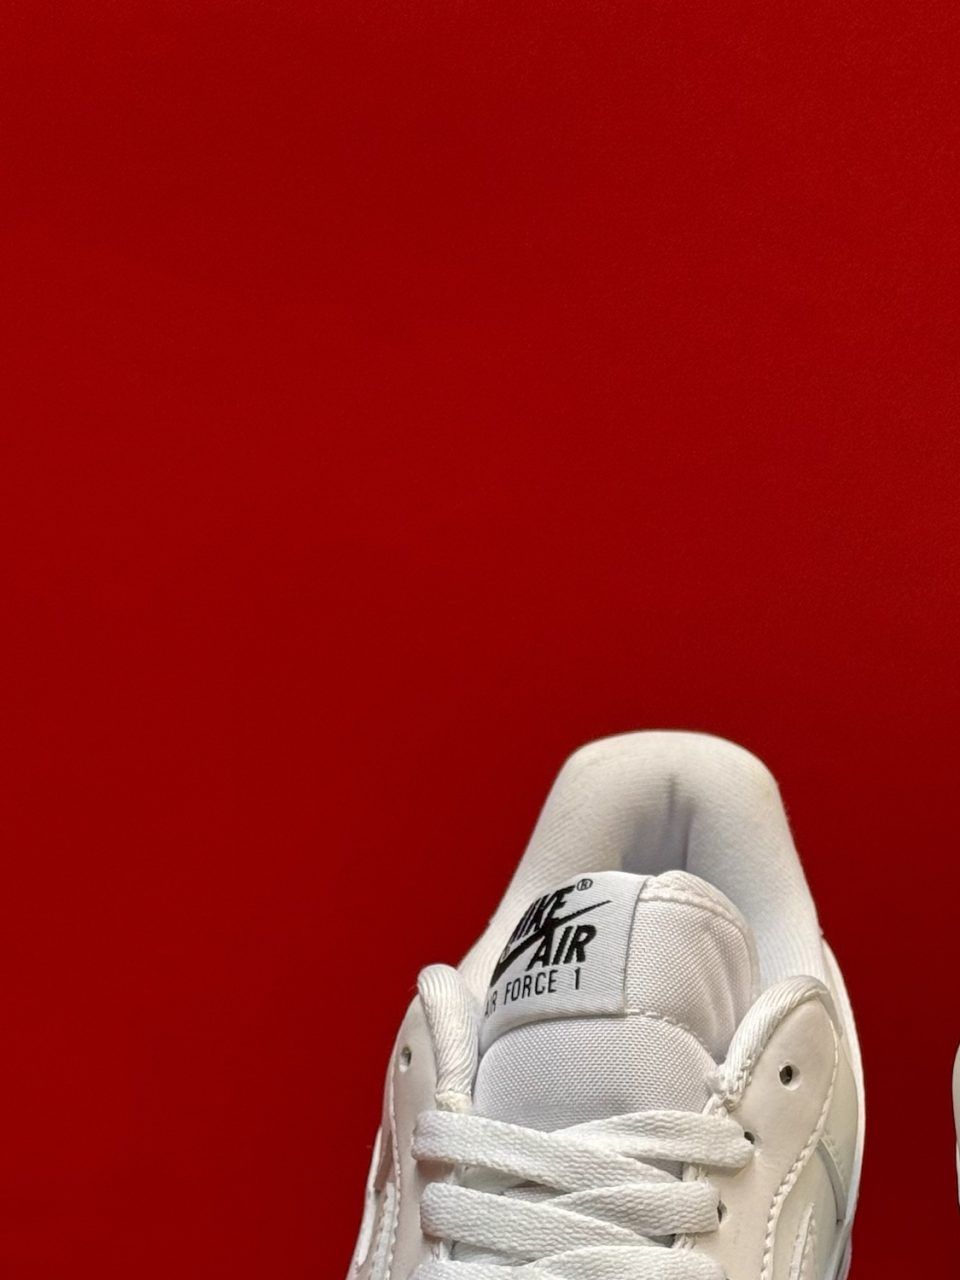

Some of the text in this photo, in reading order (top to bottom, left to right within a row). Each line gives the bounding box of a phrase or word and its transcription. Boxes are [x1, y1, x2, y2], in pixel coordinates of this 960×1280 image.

[525, 924, 597, 971] AIR
[503, 969, 558, 1005] FORCE
[574, 967, 581, 990] 1
